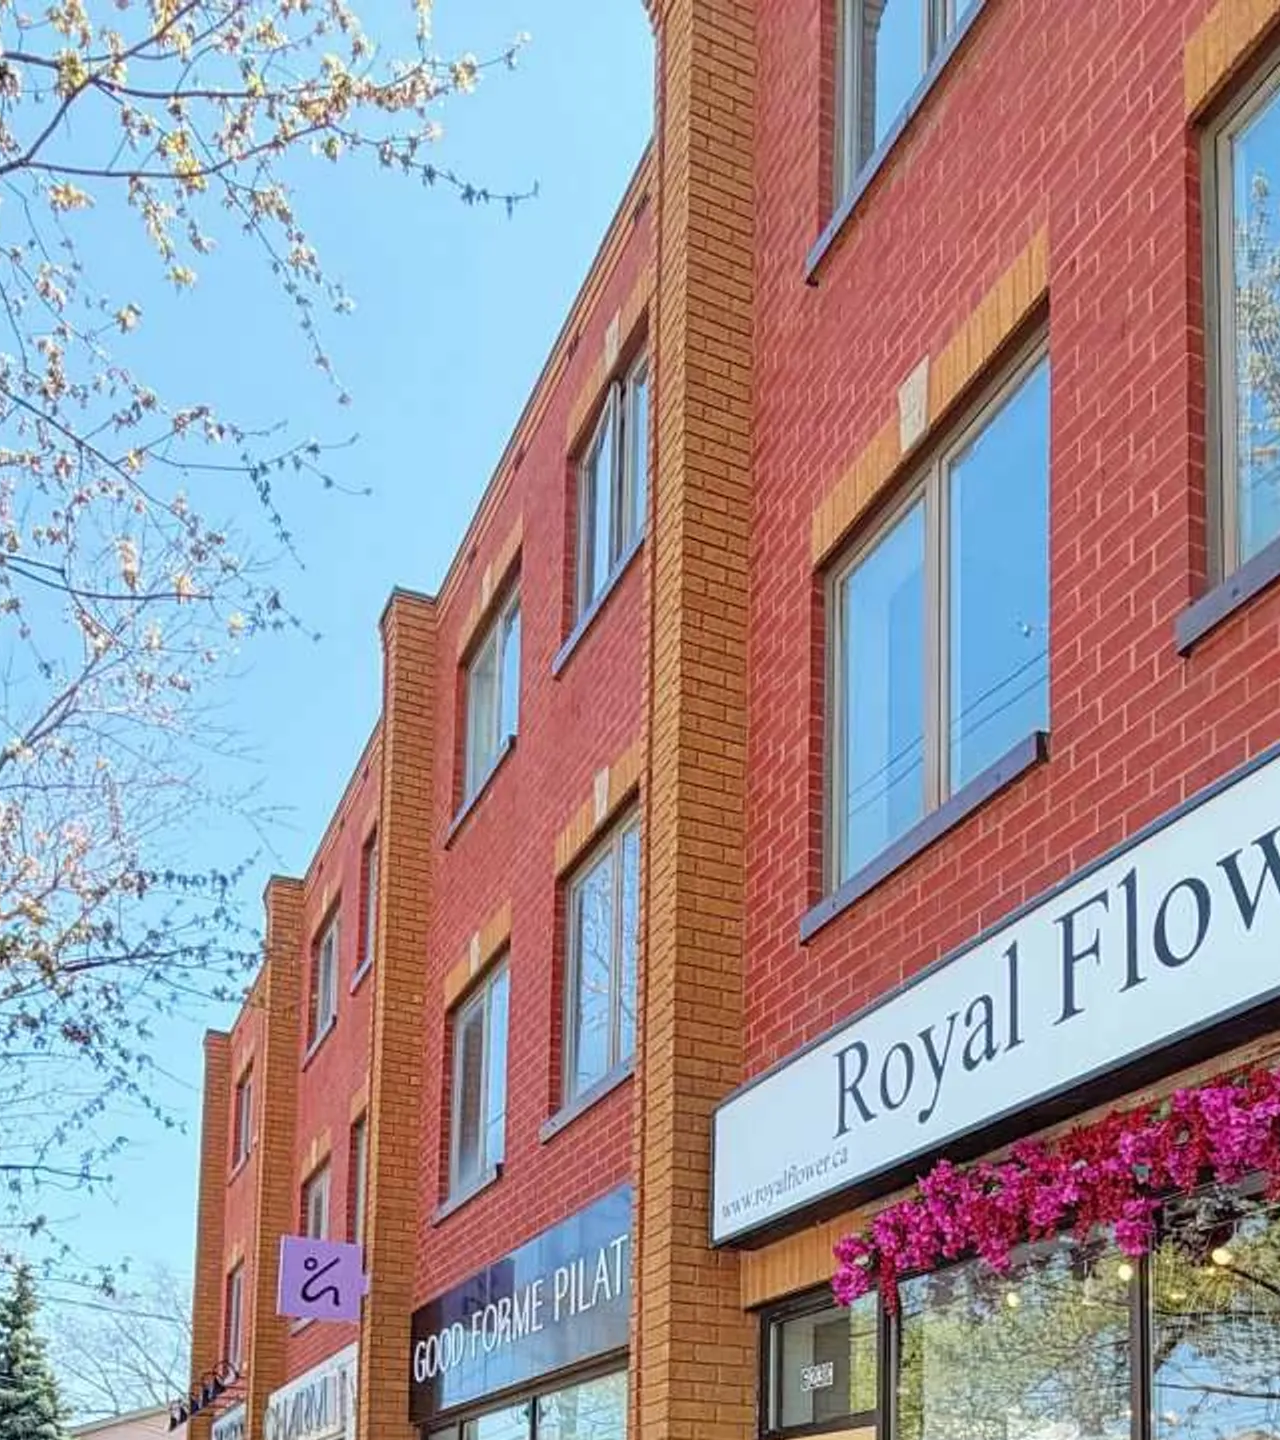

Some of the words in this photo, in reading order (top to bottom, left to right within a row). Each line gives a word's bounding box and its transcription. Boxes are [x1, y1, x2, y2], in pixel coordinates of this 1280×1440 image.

[832, 939, 1025, 1140] Royal
[721, 1147, 849, 1219] www.royalflower.ca
[413, 1322, 465, 1383] GOOD
[471, 1279, 544, 1358] FORME
[553, 1233, 630, 1322] PILAT
